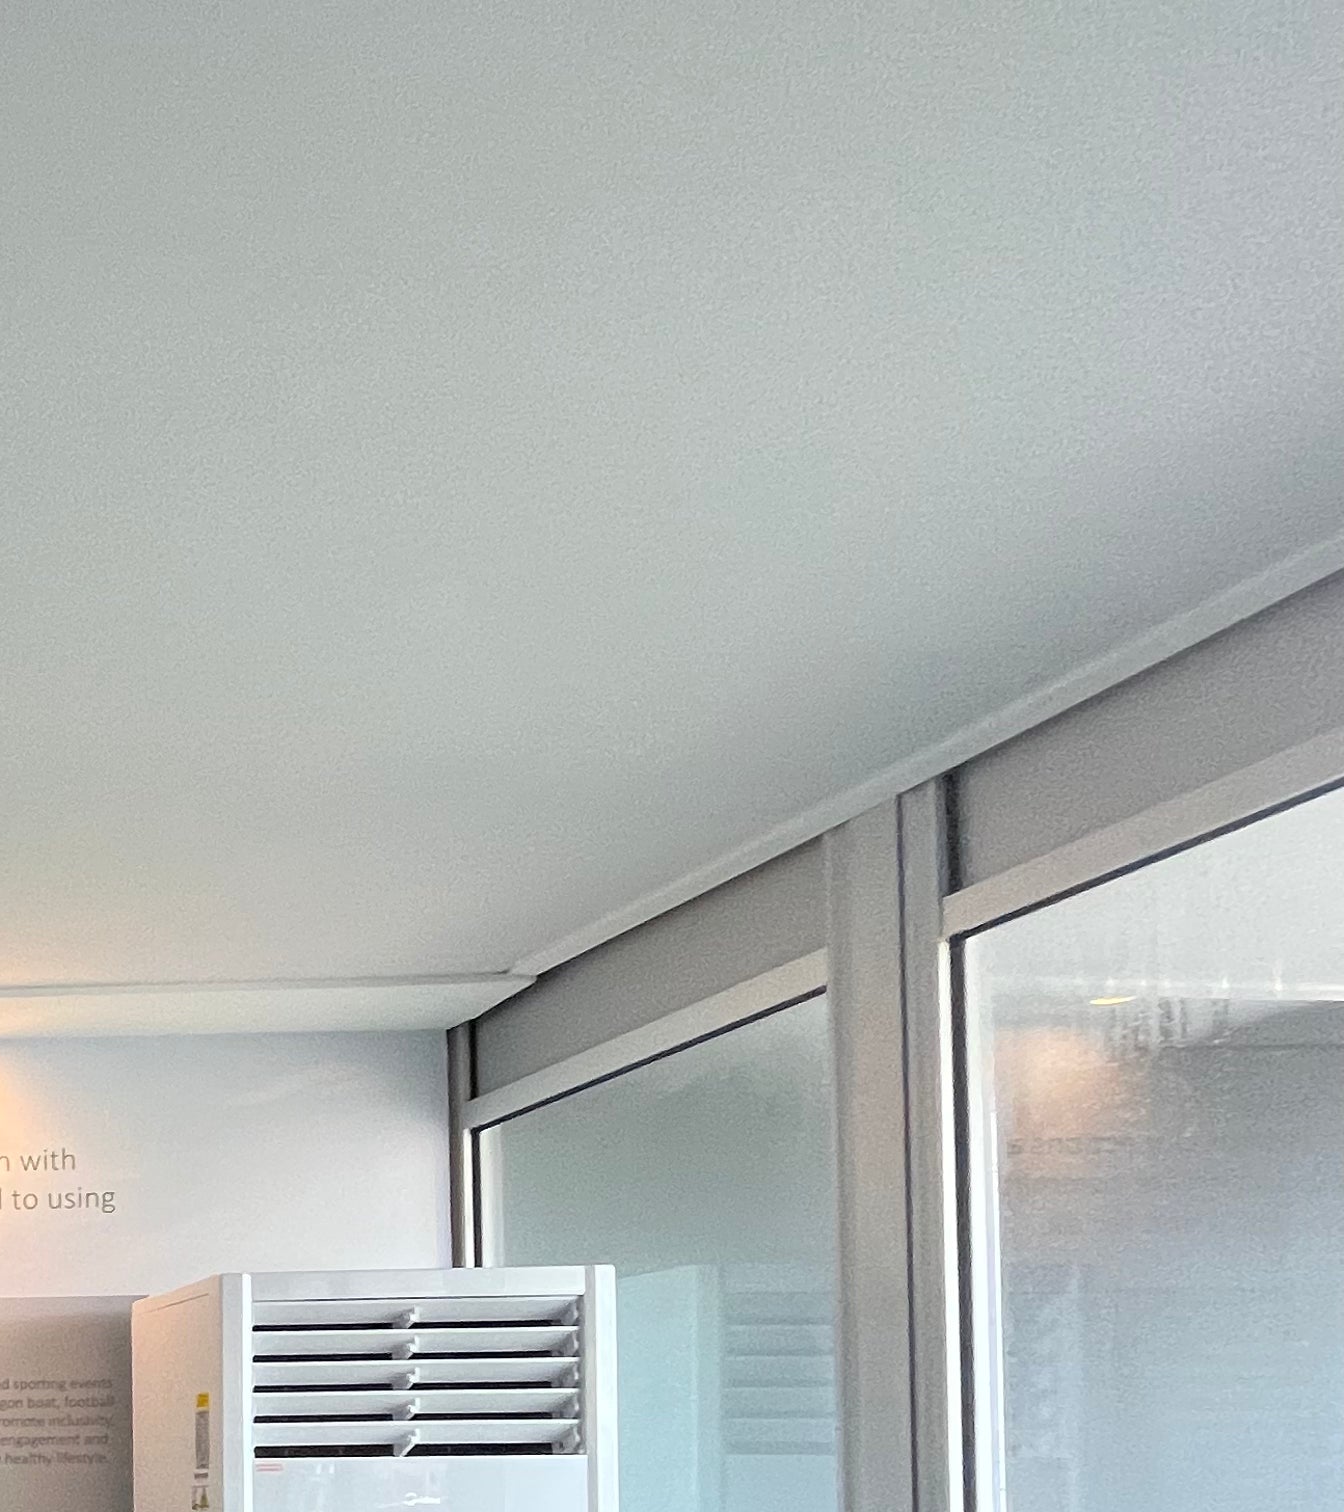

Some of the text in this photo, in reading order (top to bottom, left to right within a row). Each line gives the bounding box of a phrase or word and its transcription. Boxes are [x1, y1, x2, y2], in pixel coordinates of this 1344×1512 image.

[20, 1148, 76, 1172] with
[12, 1190, 38, 1210] to
[48, 1187, 116, 1214] using
